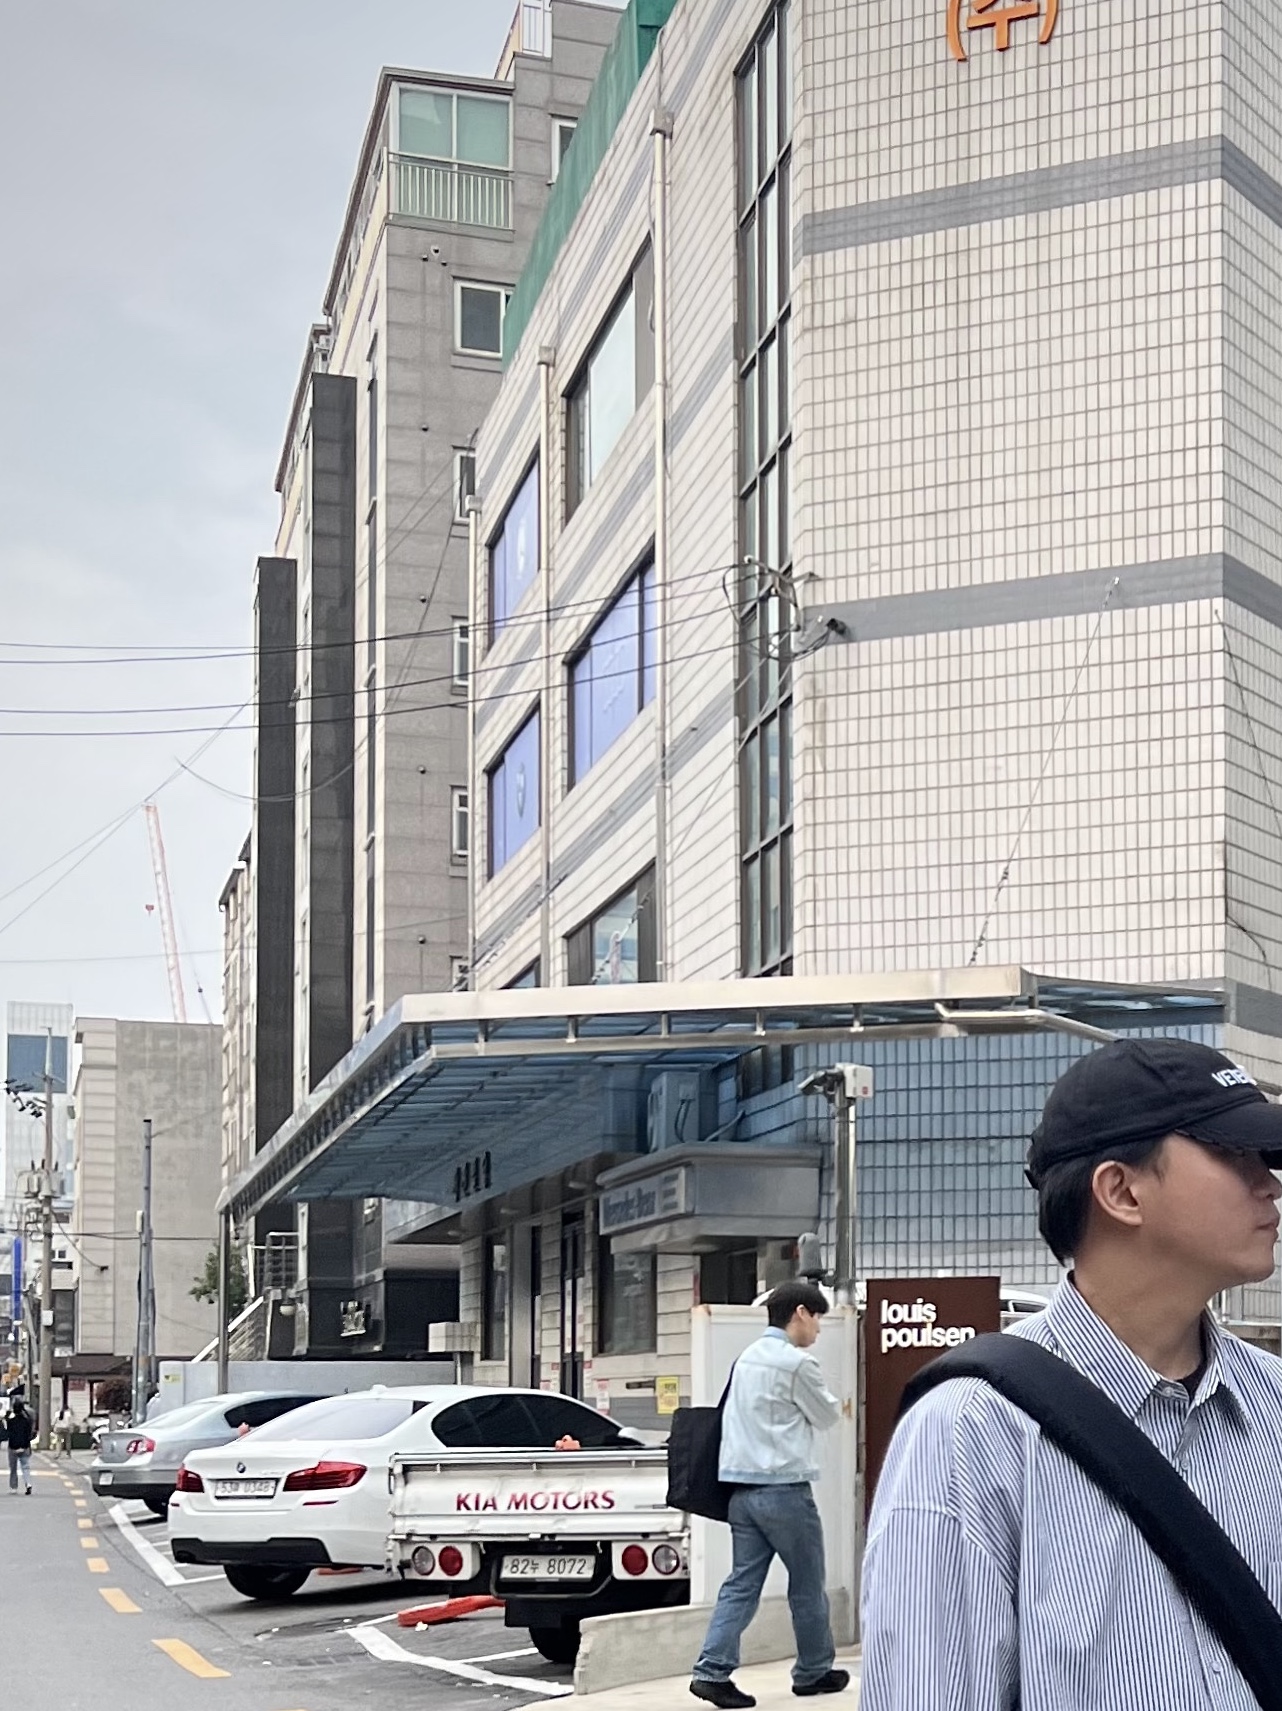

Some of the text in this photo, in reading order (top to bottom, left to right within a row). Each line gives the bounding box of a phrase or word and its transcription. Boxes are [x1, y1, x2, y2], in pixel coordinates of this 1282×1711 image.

[881, 1298, 937, 1324] louis
[881, 1323, 976, 1353] poulsen
[456, 1490, 615, 1511] KIA MOTORS
[547, 1558, 587, 1575] 8072
